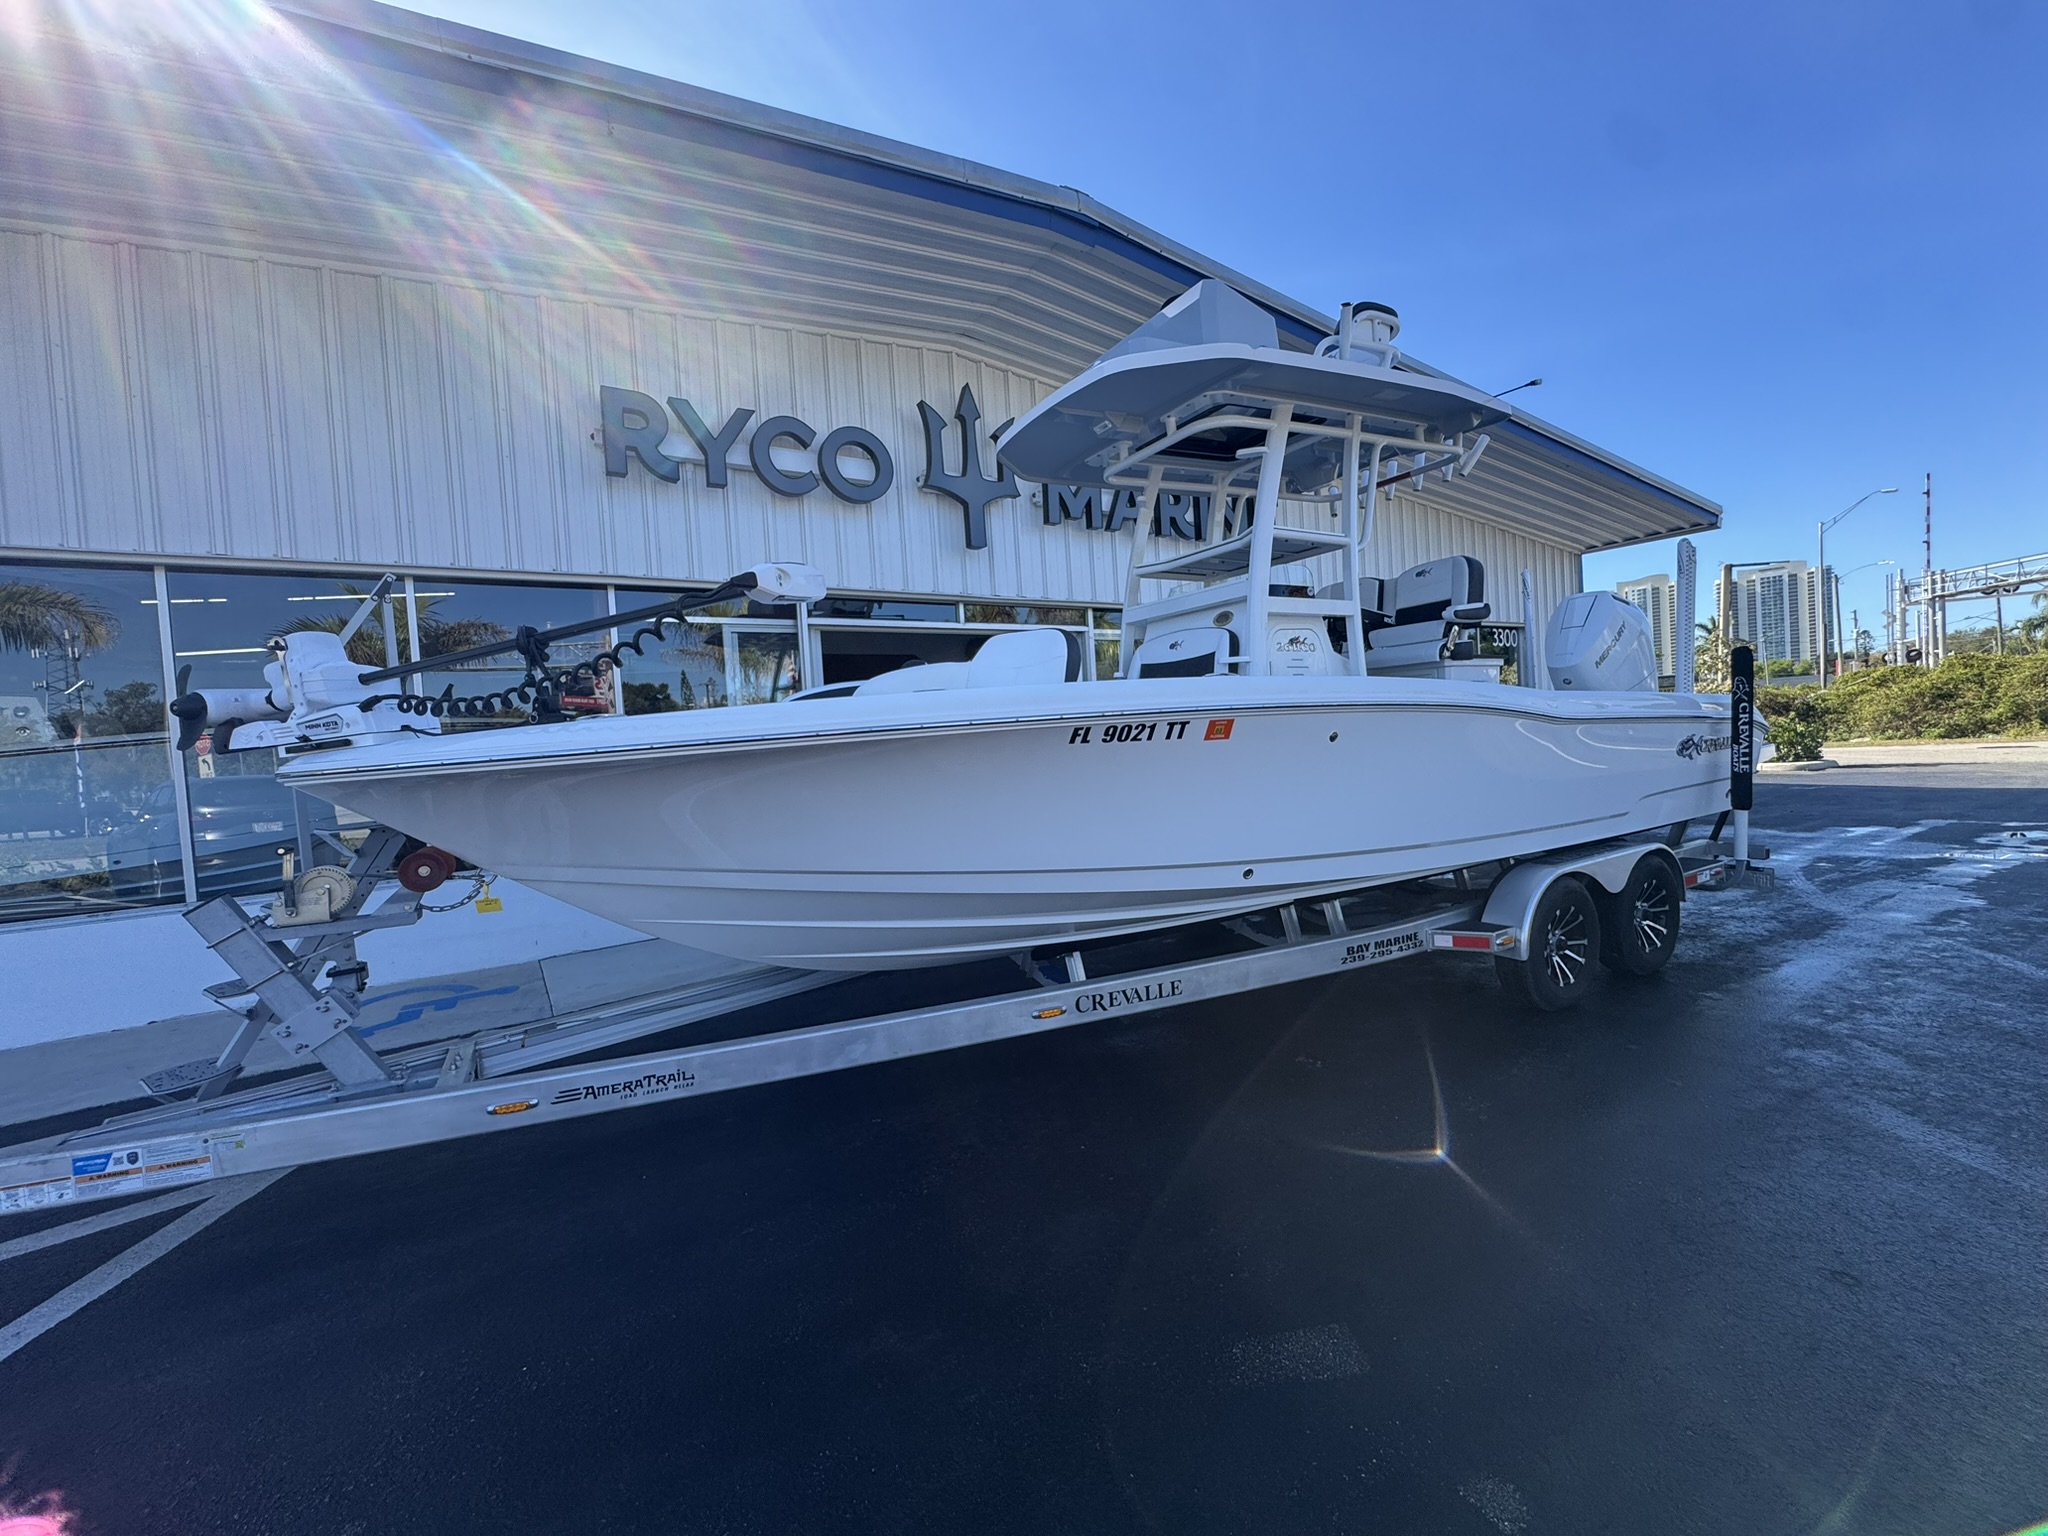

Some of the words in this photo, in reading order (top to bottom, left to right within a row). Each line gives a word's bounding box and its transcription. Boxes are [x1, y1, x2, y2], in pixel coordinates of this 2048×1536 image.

[600, 385, 895, 505] RYCO
[1042, 483, 1278, 542] MARIN
[1492, 628, 1518, 647] 3300
[1594, 620, 1627, 669] MERCURY
[1068, 727, 1092, 744] FL
[1101, 723, 1157, 743] 9021
[1164, 721, 1191, 740] TT
[1737, 702, 1750, 773] CREVALLE
[1346, 942, 1371, 956] BAY
[1374, 932, 1420, 950] MARINE
[1075, 979, 1183, 1013] CREVALLE
